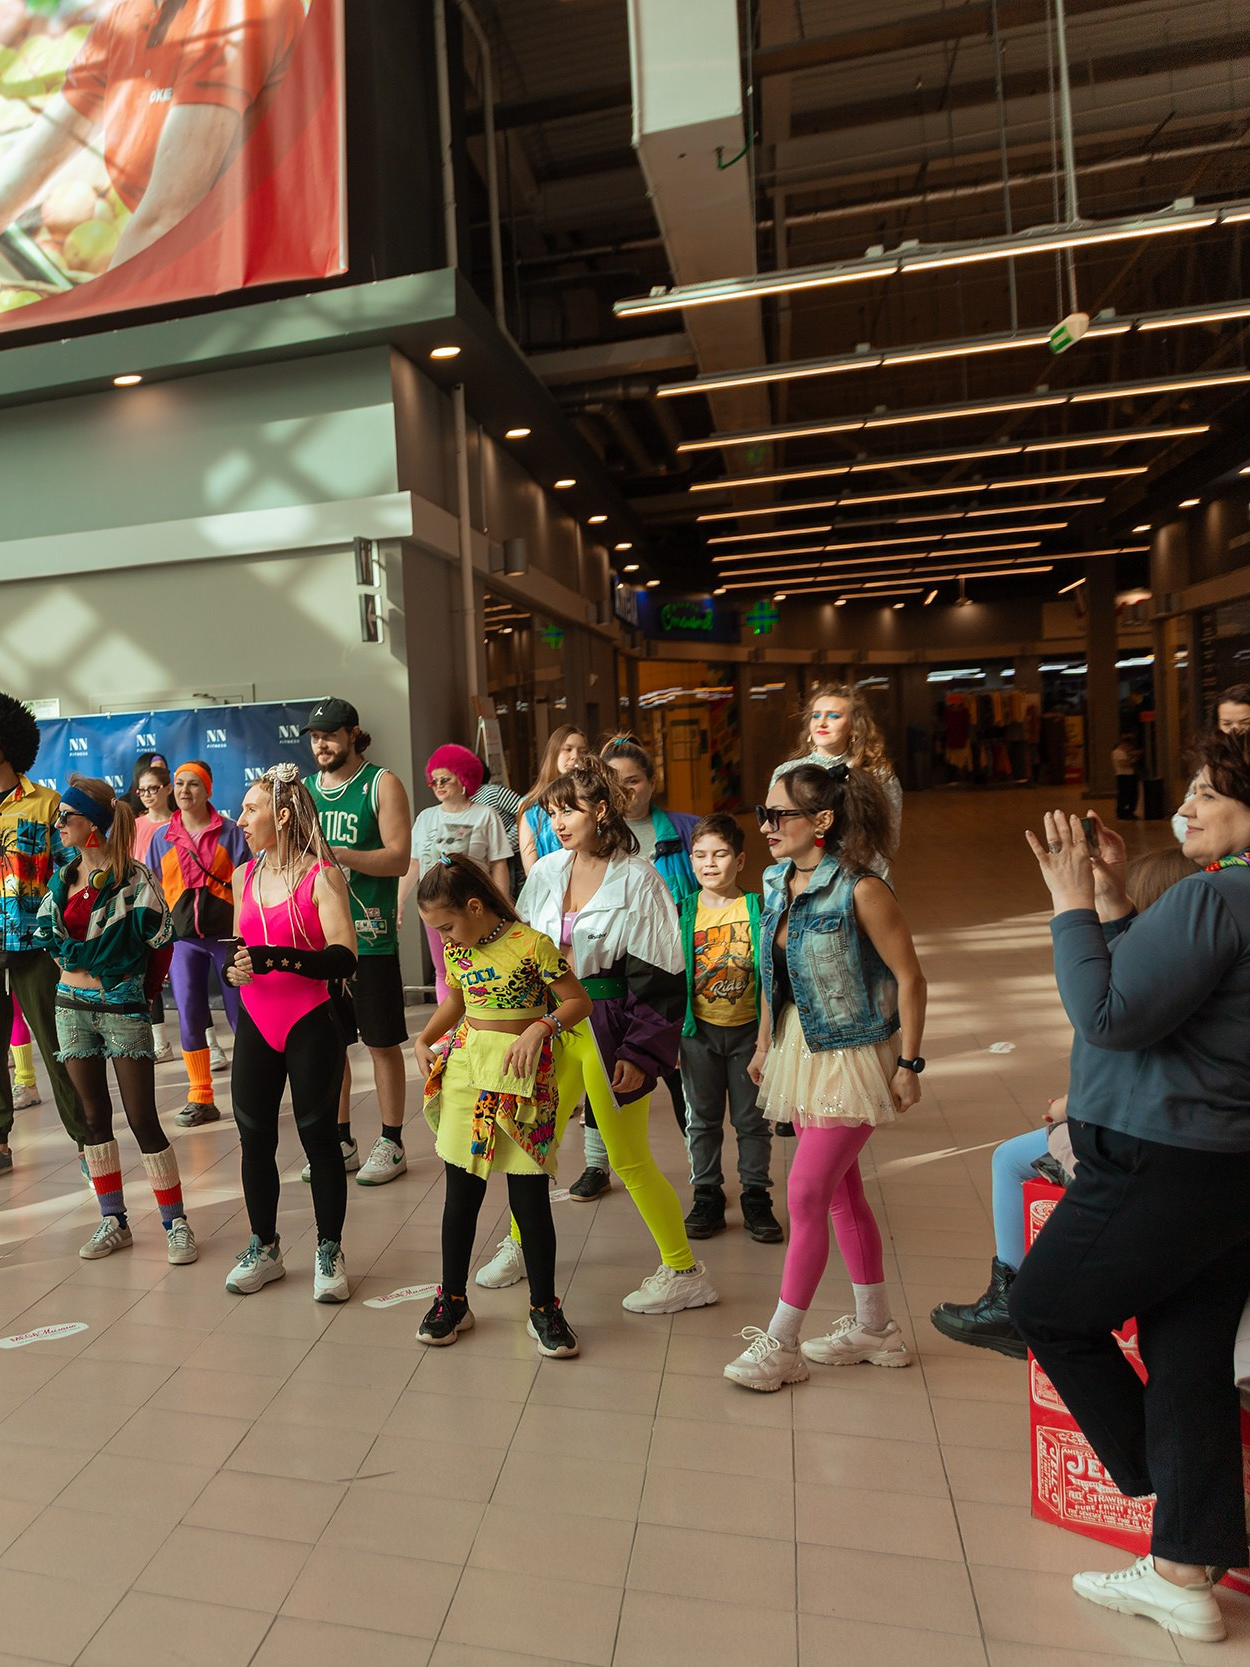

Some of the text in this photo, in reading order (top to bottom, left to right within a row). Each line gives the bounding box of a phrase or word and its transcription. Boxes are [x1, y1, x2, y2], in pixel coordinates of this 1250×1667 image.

[206, 729, 227, 743] NN
[278, 724, 300, 739] NN
[69, 737, 88, 751] NN
[136, 733, 156, 747] NN
[1086, 1493, 1149, 1514] STRAWBERRY
